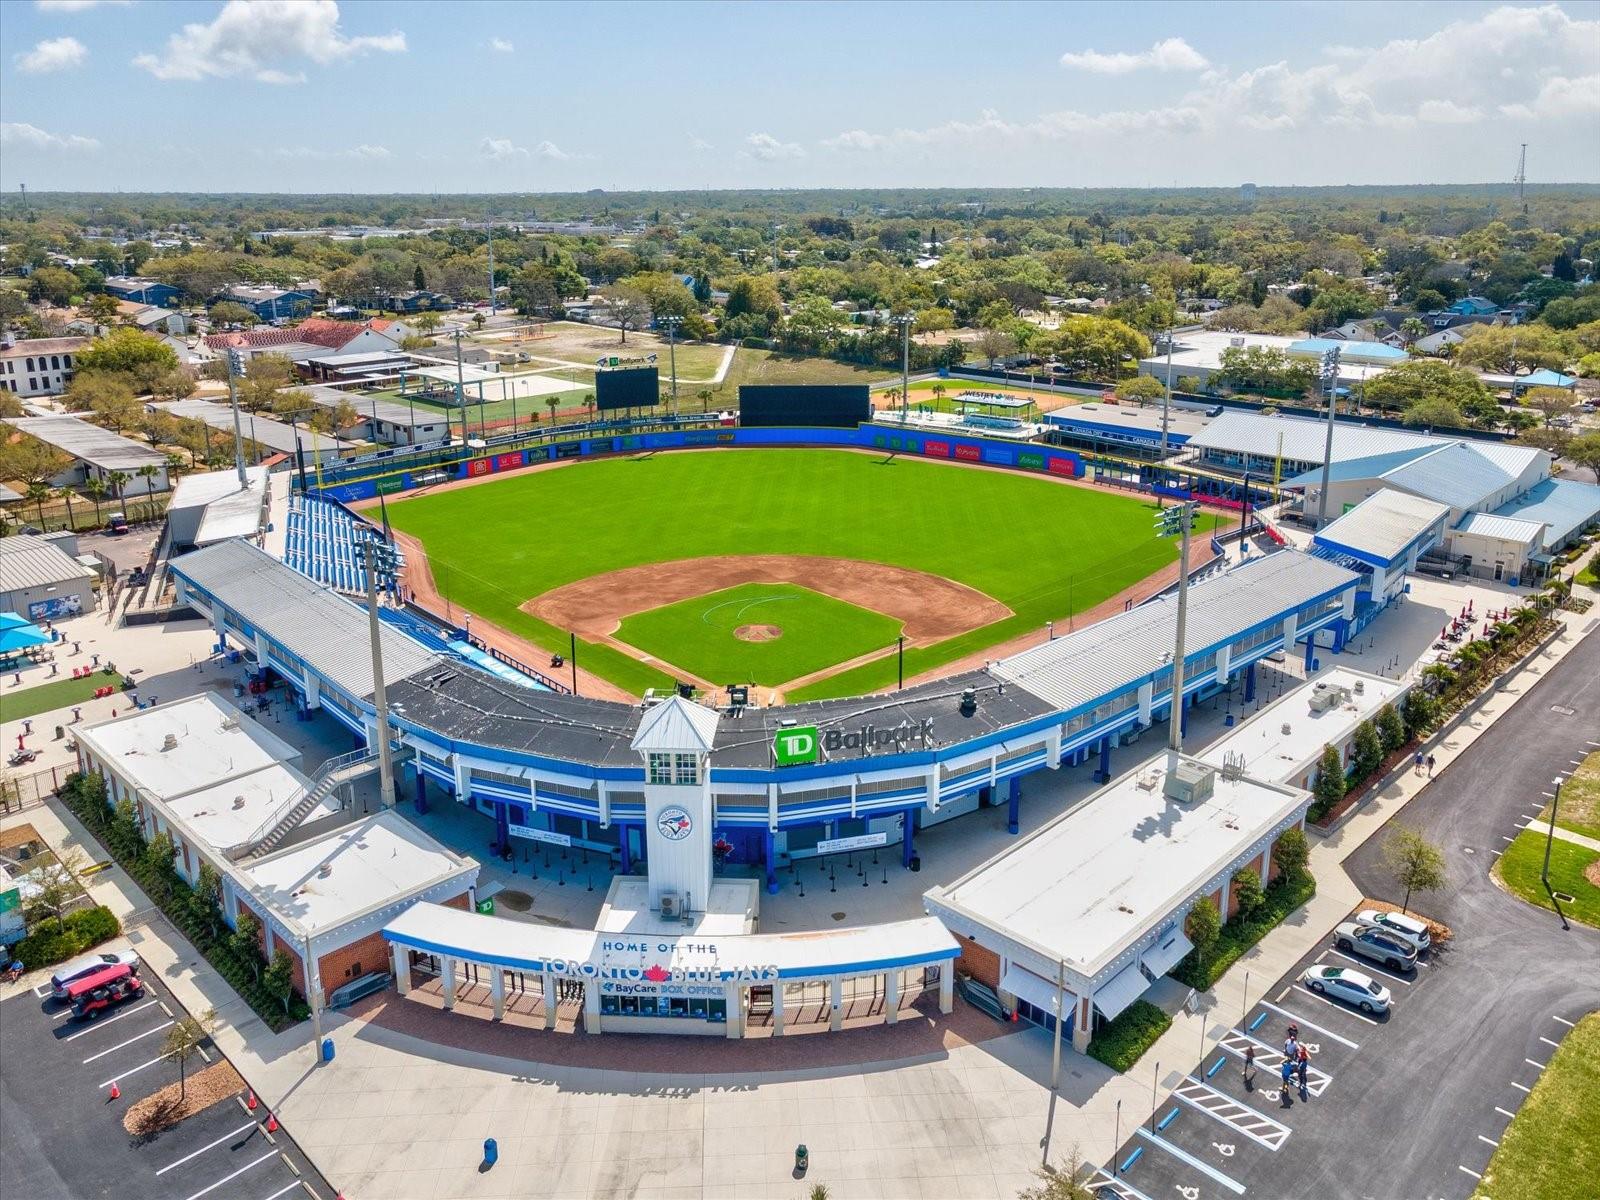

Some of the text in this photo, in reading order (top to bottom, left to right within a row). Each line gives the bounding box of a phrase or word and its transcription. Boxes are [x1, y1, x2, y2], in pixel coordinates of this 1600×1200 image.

[780, 718, 934, 757] TD Ballpark
[603, 942, 717, 953] HOME OF THE
[538, 957, 779, 982] TORONTO BLUE JAYS
[615, 984, 724, 995] BayCare BOX OFFICE
